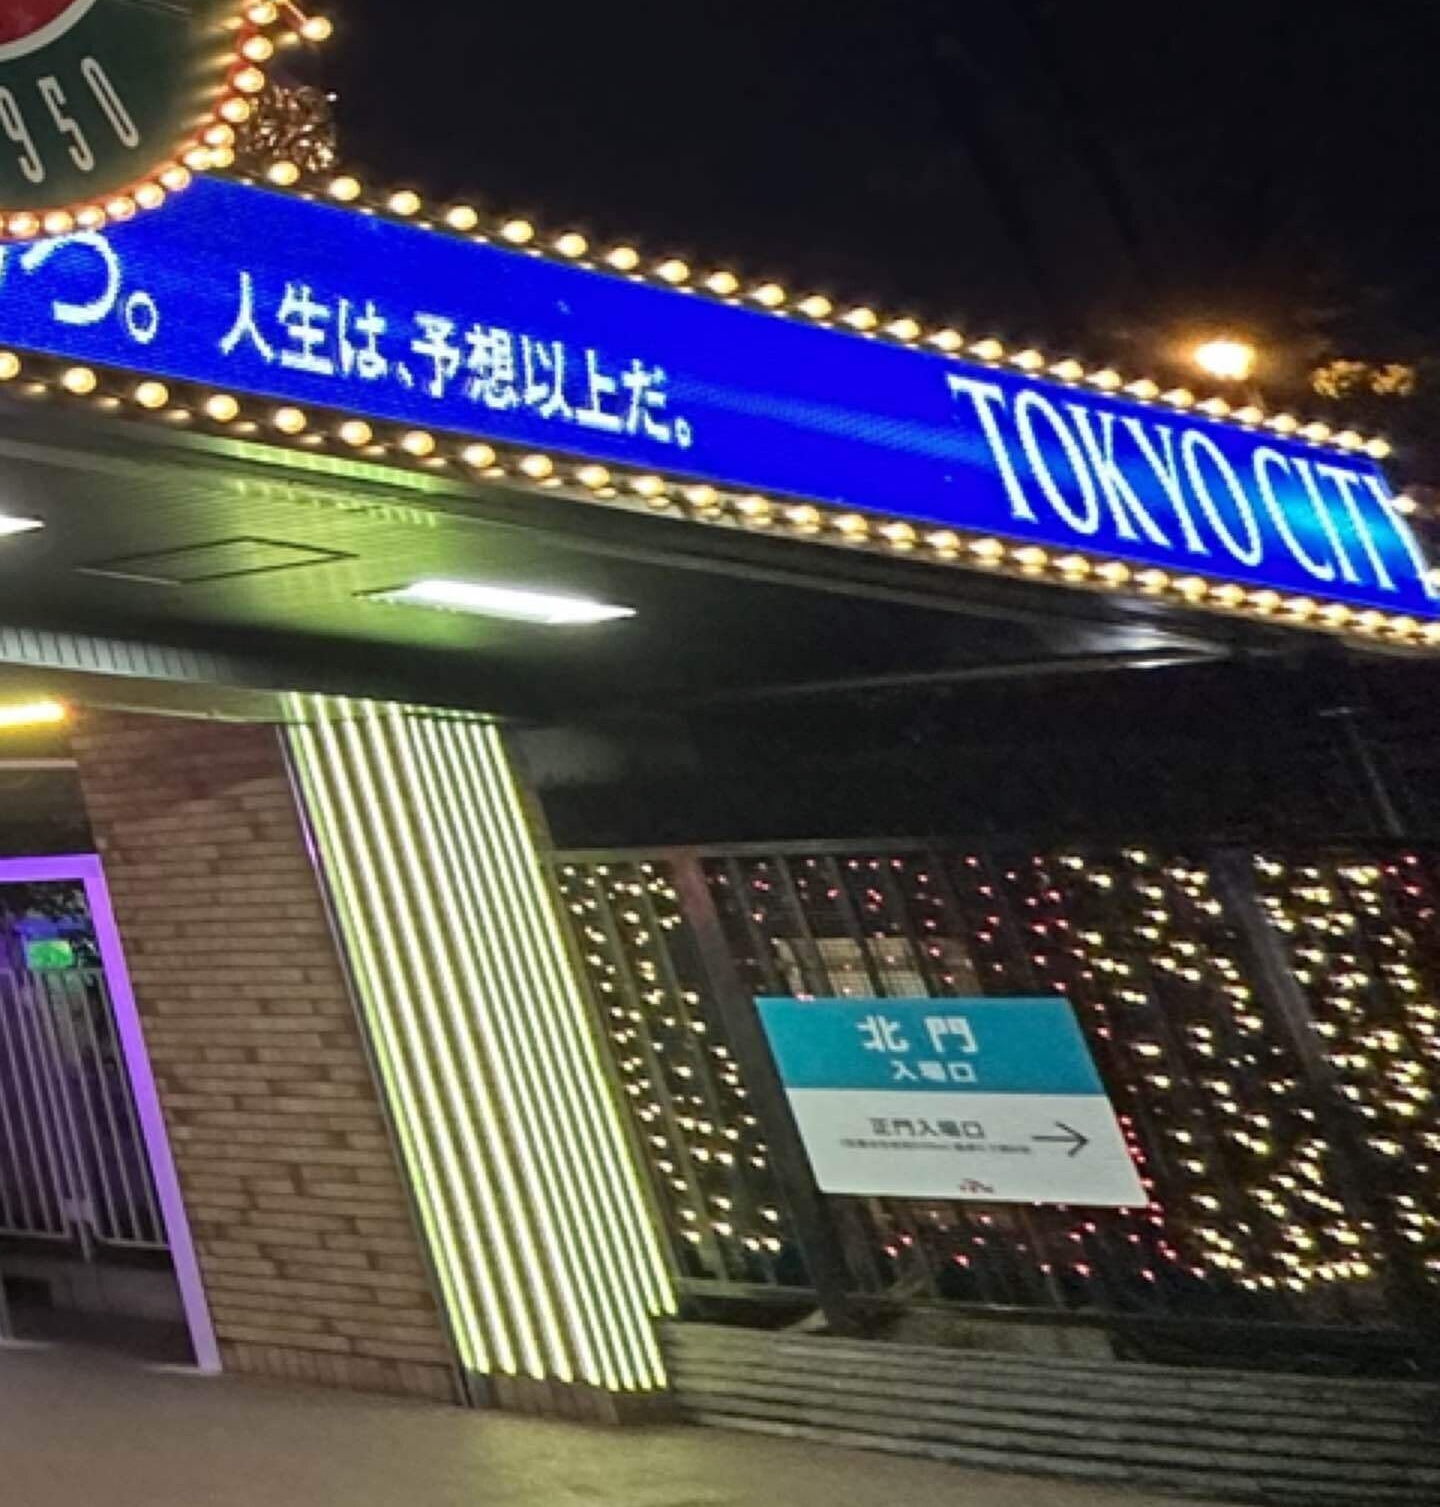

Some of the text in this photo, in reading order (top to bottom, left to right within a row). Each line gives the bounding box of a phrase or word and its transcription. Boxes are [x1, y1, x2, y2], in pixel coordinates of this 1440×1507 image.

[218, 270, 694, 449] 人生は、予想以上だ。
[946, 372, 1264, 567] TOKYO
[856, 1015, 978, 1053] 北門
